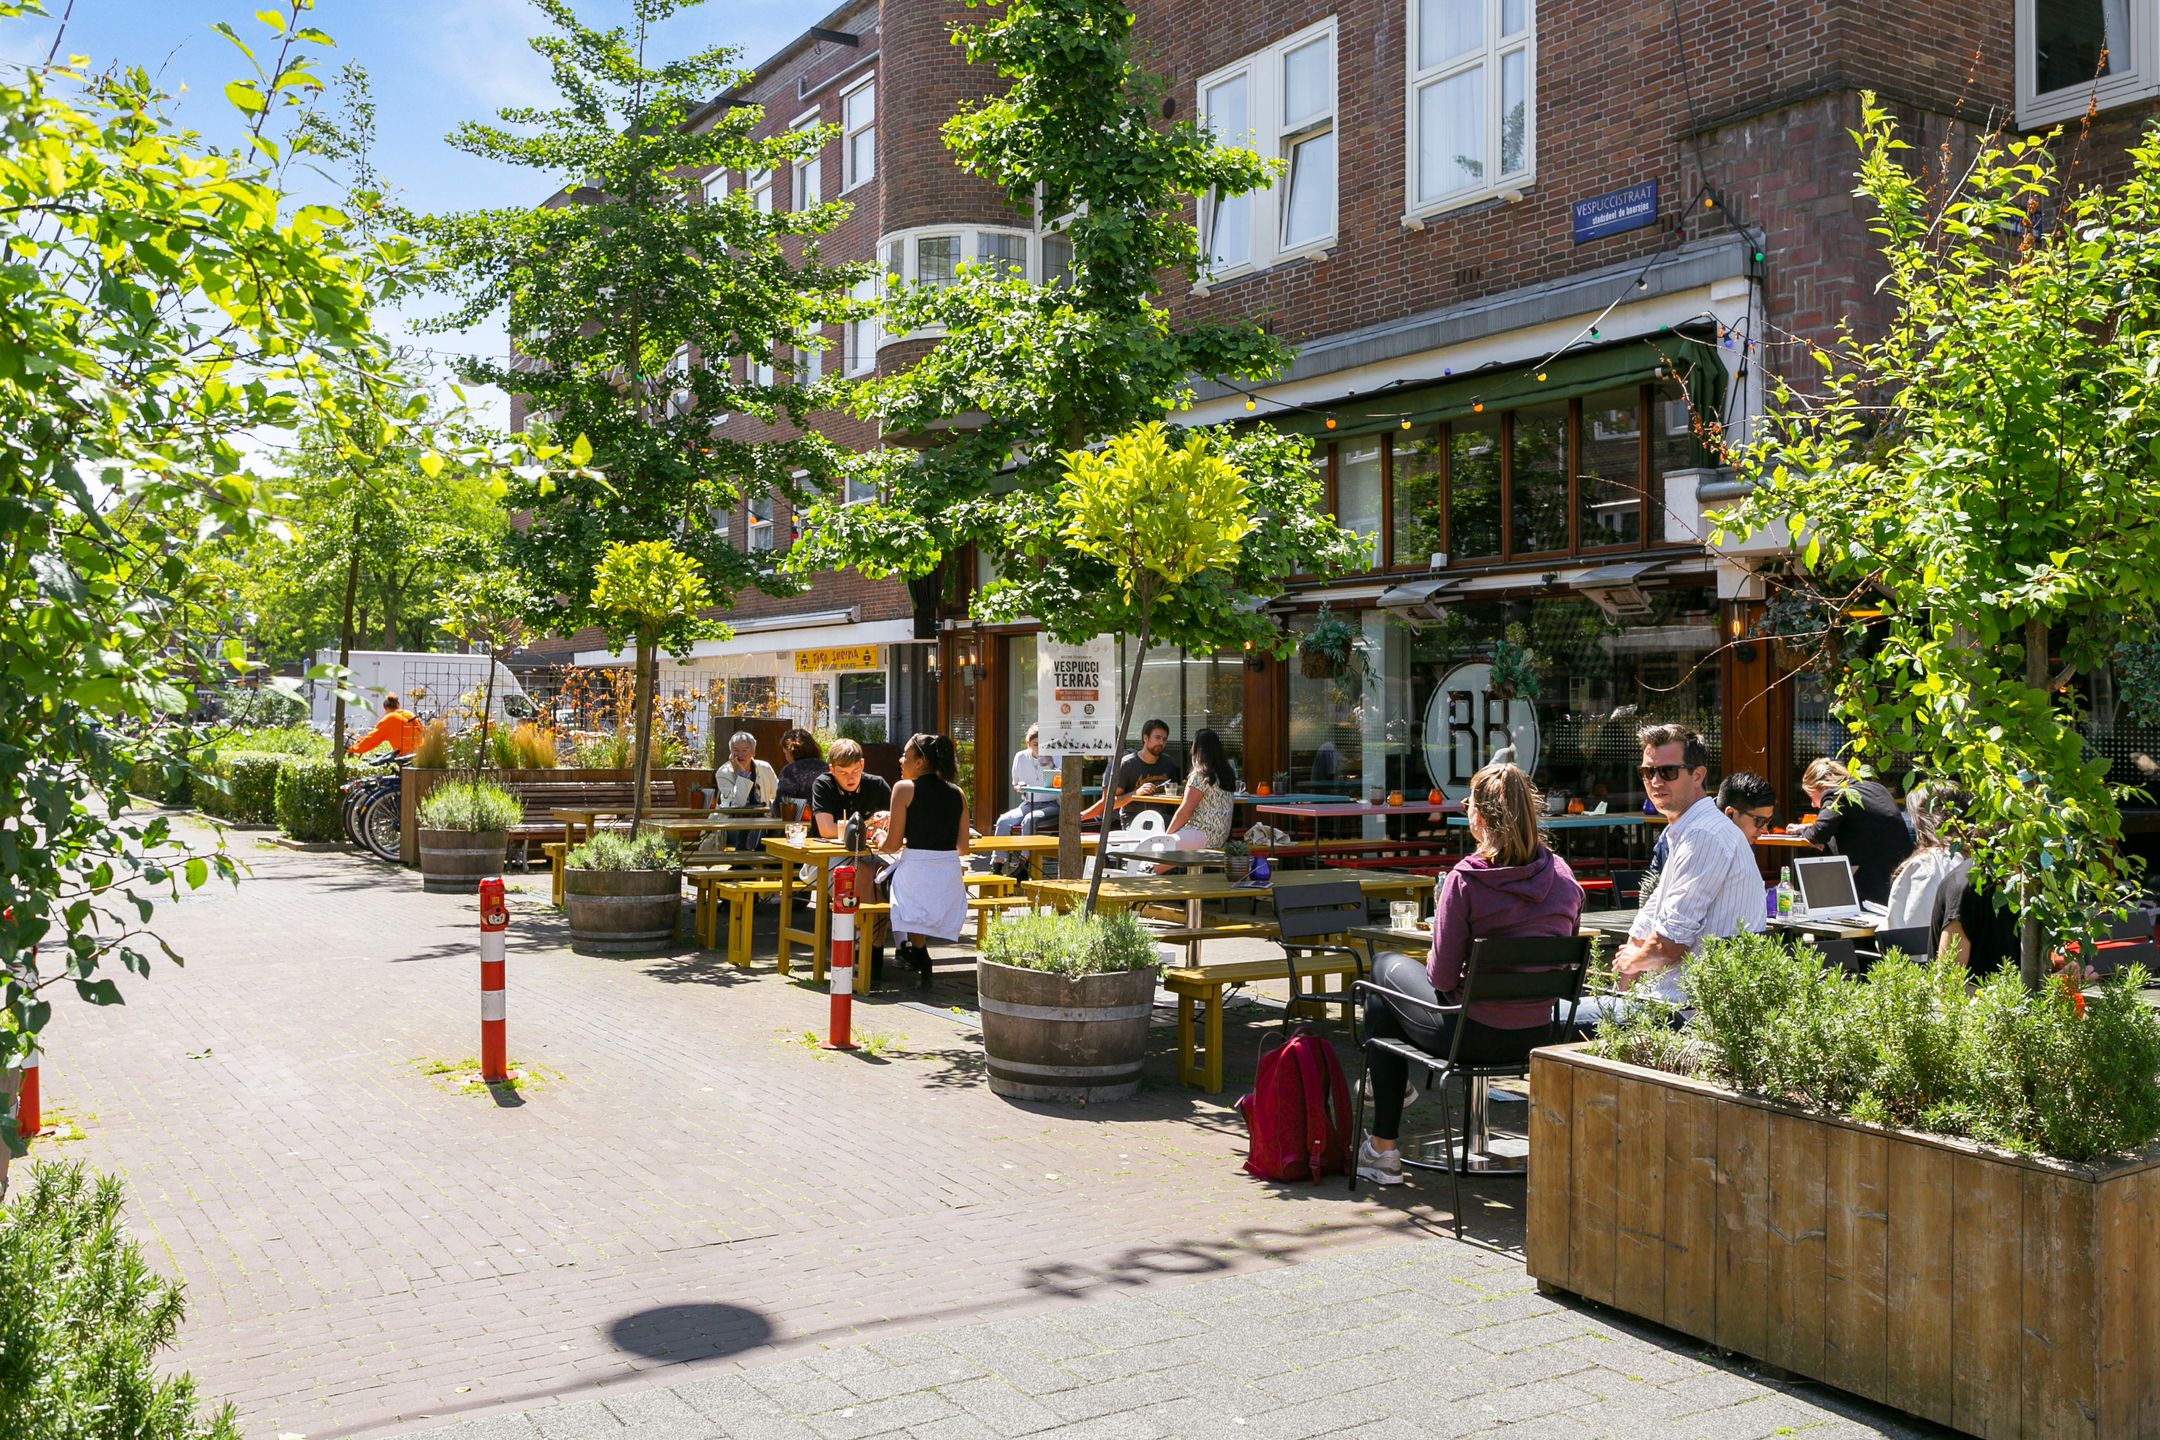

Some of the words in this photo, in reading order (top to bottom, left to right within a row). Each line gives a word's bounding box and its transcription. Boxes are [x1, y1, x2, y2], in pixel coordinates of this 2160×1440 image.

[1576, 185, 1652, 216] VESPUCCISTRAAT
[1054, 661, 1099, 673] VESPUCCI
[1054, 674, 1099, 687] TERRAS
